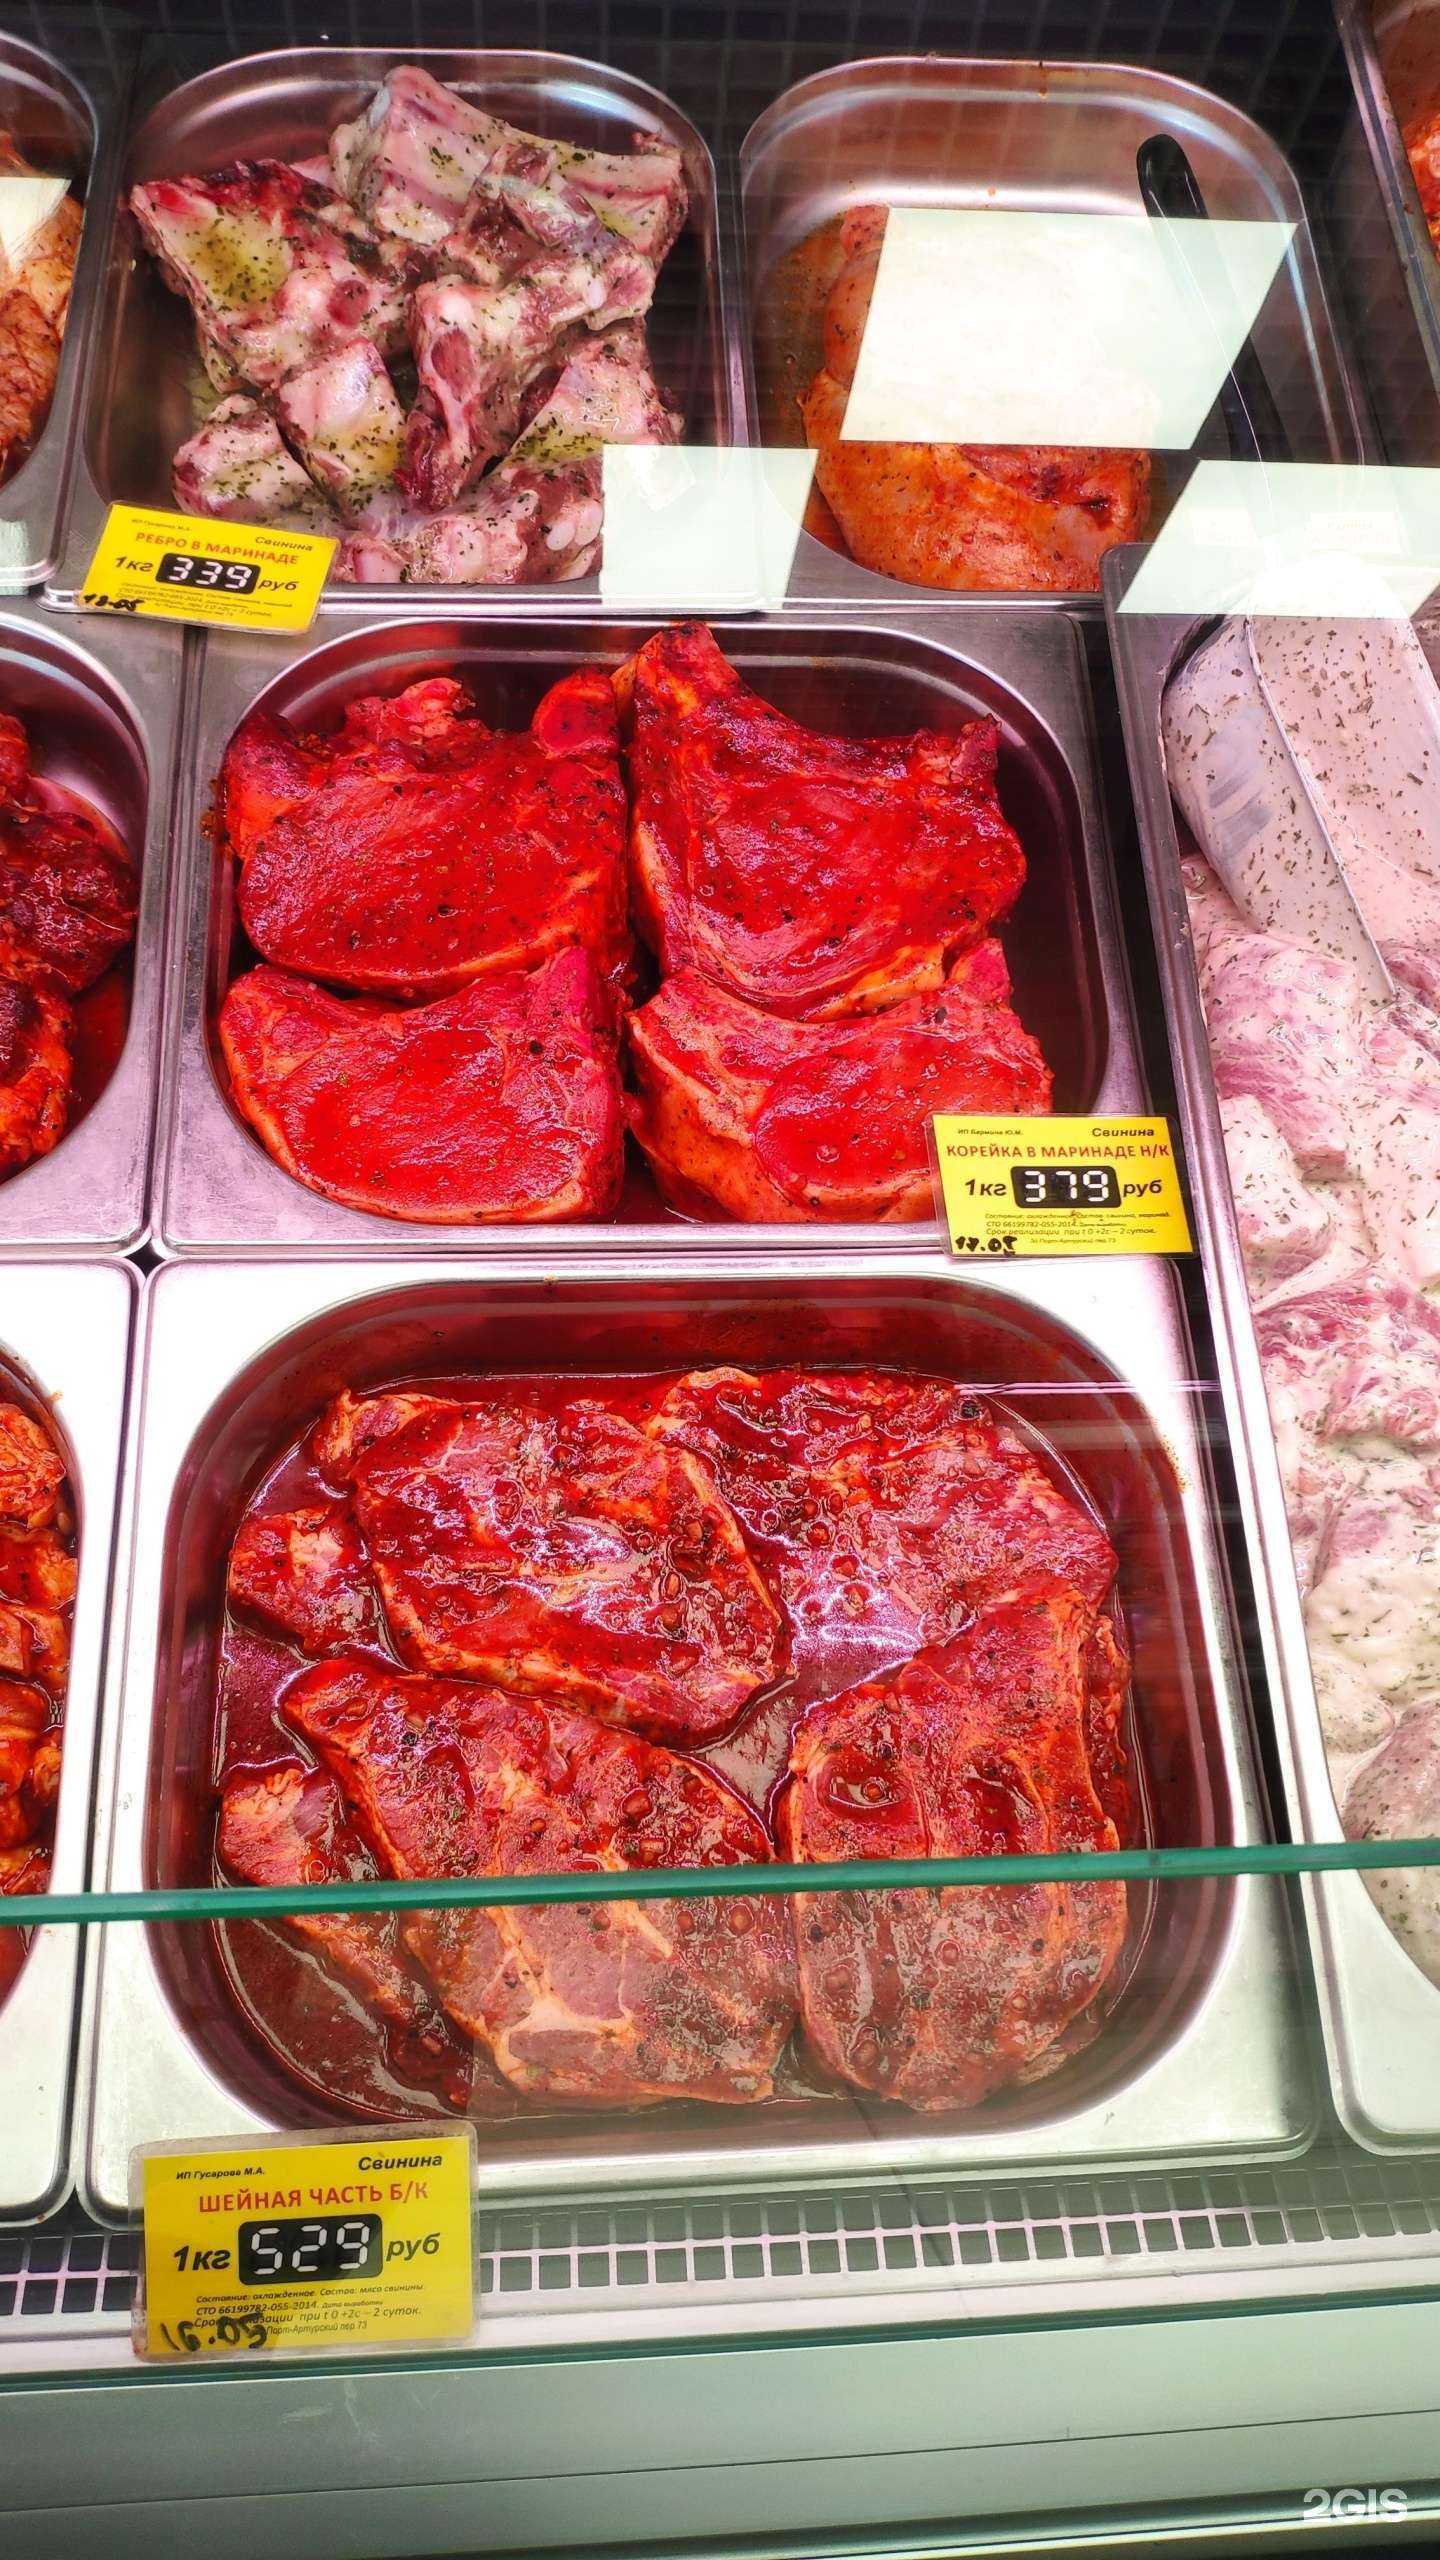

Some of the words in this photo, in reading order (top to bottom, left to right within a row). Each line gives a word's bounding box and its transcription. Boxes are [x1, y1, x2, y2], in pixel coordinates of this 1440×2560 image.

[135, 531, 187, 548] РЕБРО
[191, 540, 201, 550] В
[204, 543, 299, 565] МАРИНАДЕ
[255, 535, 314, 552] Свинина
[115, 556, 154, 573] 1кг
[168, 556, 252, 589] 339
[258, 579, 299, 592] руб
[1091, 1127, 1155, 1138] Свинина
[946, 1142, 1021, 1158] КОРЕЙКА
[1027, 1147, 1037, 1158] В
[1041, 1145, 1135, 1160] МАРИНАДЕ
[1140, 1144, 1171, 1157] Н/К
[964, 1178, 1008, 1197] 1кг
[1024, 1170, 1110, 1203] 379
[1123, 1179, 1163, 1198] руб
[176, 2171, 191, 2180] ИП
[243, 2166, 265, 2176] М.А.
[358, 2153, 443, 2172] Свинина
[199, 2188, 302, 2214] ШЕЙНАЯ
[309, 2183, 383, 2206] ЧАСТЬ
[389, 2181, 429, 2203] Б/К
[173, 2245, 231, 2272] 1кг
[251, 2221, 370, 2275] 529
[386, 2232, 441, 2262] руб
[360, 2286, 383, 2294] мясо
[194, 2318, 225, 2329] Сро
[300, 2312, 320, 2323] при
[196, 2306, 217, 2316] СТО
